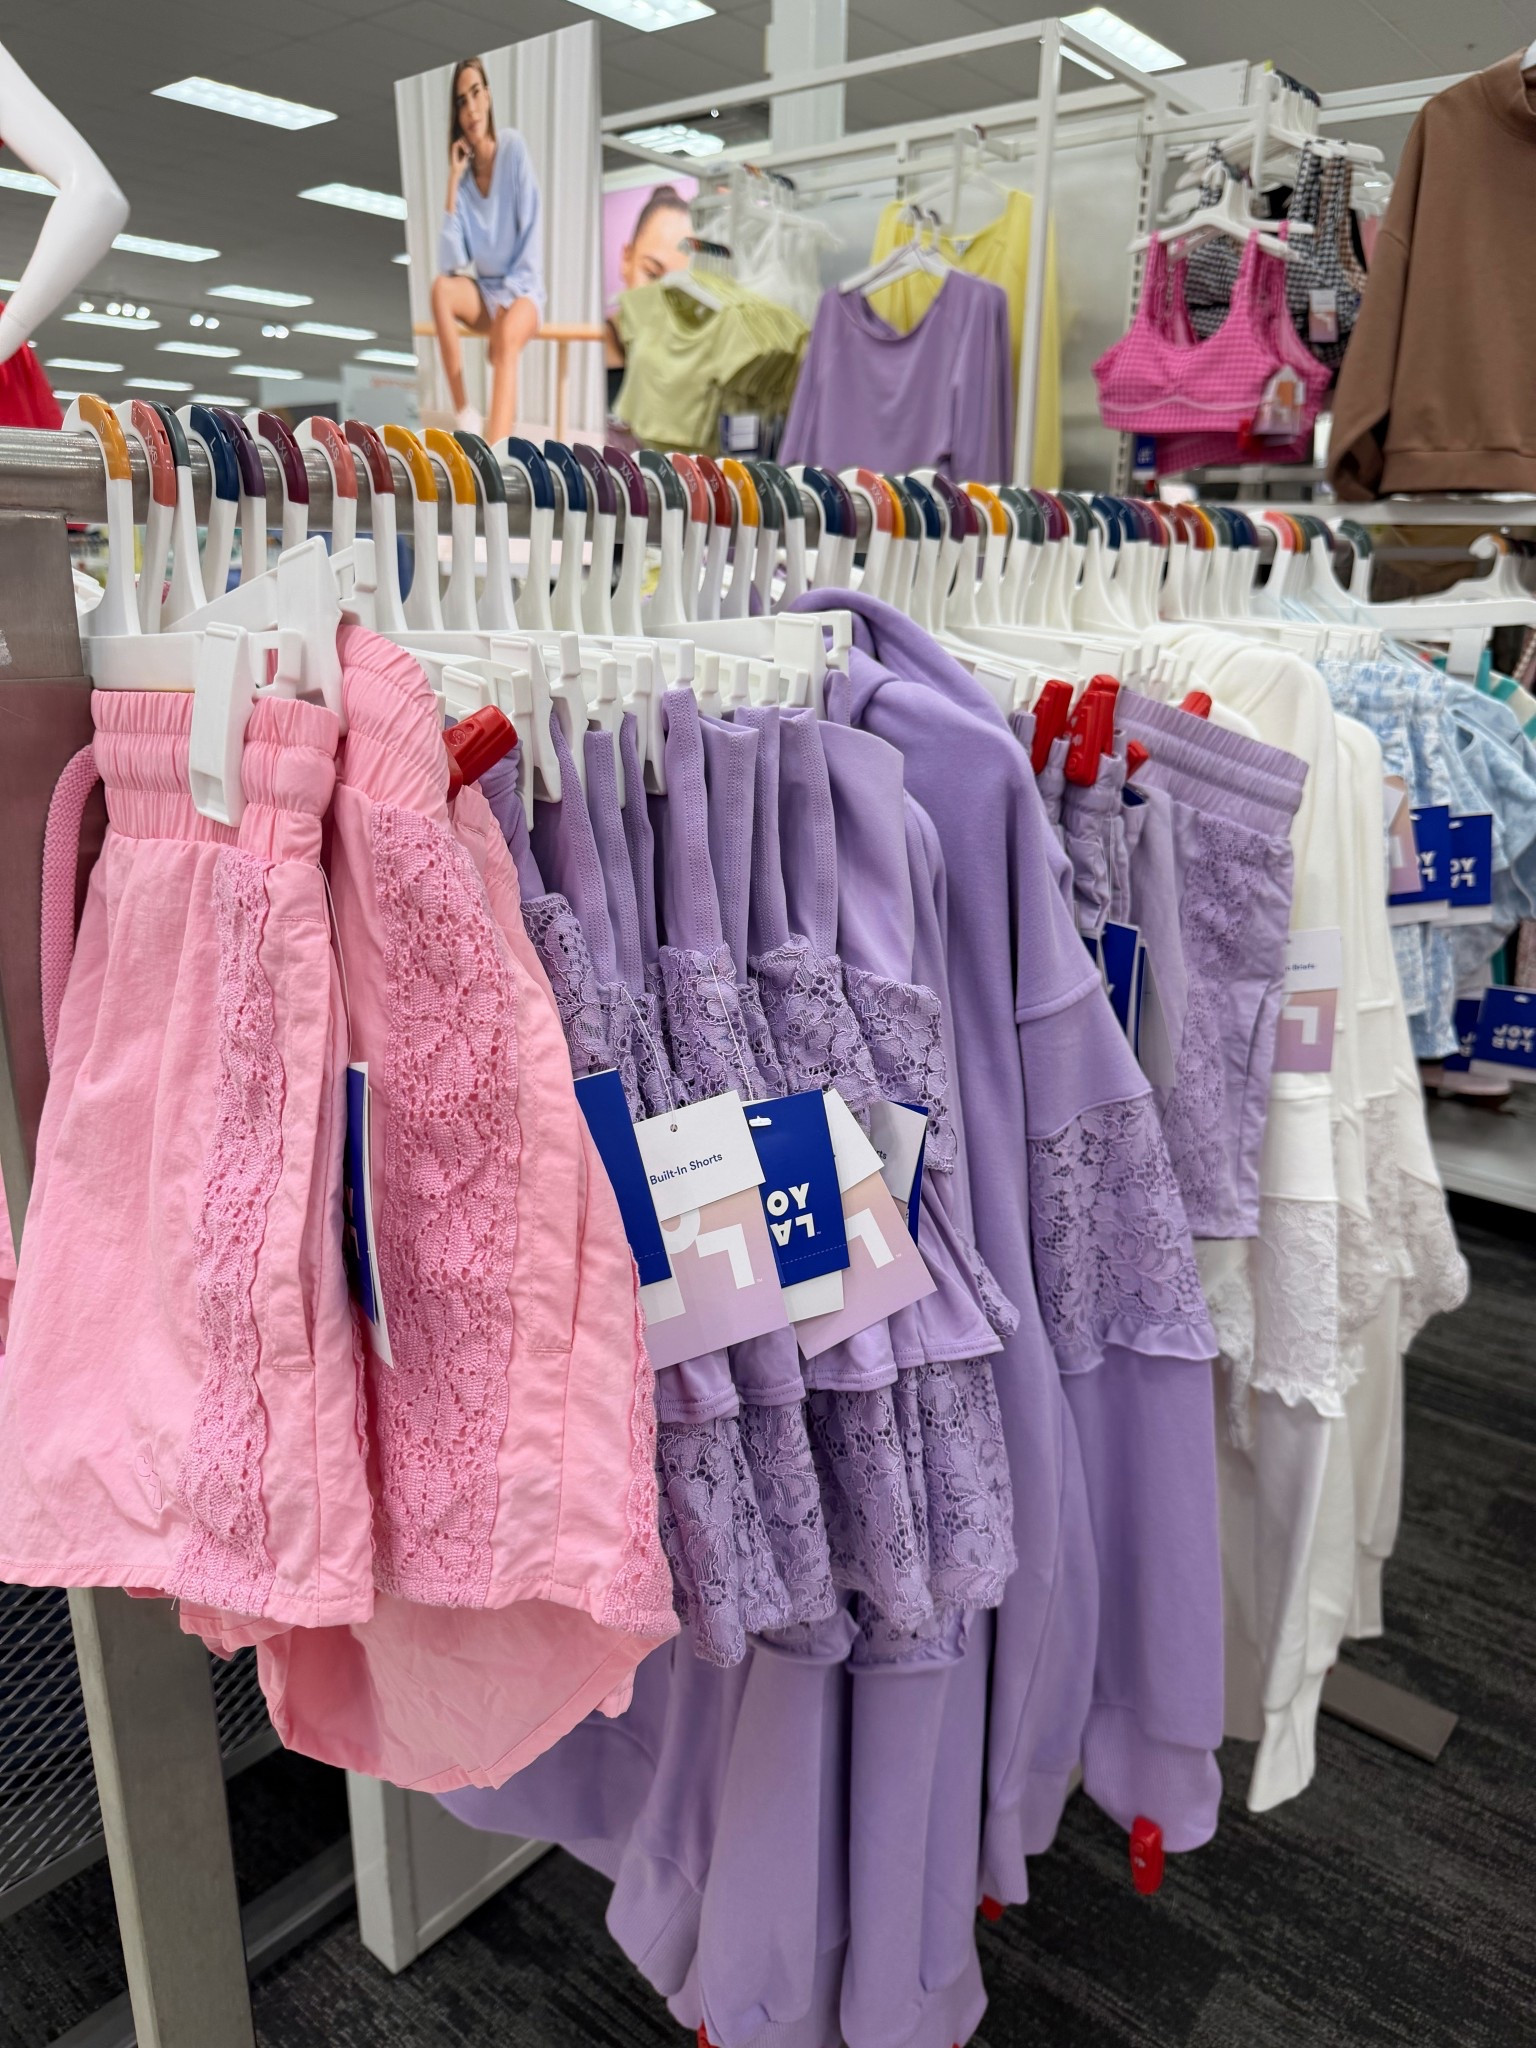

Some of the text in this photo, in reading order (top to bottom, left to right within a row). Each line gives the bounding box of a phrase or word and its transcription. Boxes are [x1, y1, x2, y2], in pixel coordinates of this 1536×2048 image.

[209, 436, 217, 452] L
[274, 432, 289, 464] XXL
[325, 430, 340, 461] XXS
[361, 435, 373, 457] XS
[406, 448, 415, 462] S
[474, 450, 485, 467] M
[526, 455, 535, 469] L
[561, 458, 569, 473] L
[590, 461, 602, 482] XL
[618, 460, 636, 488] XXL
[657, 463, 669, 479] M
[684, 468, 699, 493] XXS
[708, 474, 720, 493] XS
[1449, 856, 1477, 872] OY
[1493, 1023, 1535, 1040] JOY
[876, 1149, 887, 1160] rts
[649, 1153, 723, 1186] Built-In Shorts
[766, 1182, 810, 1217] OY
